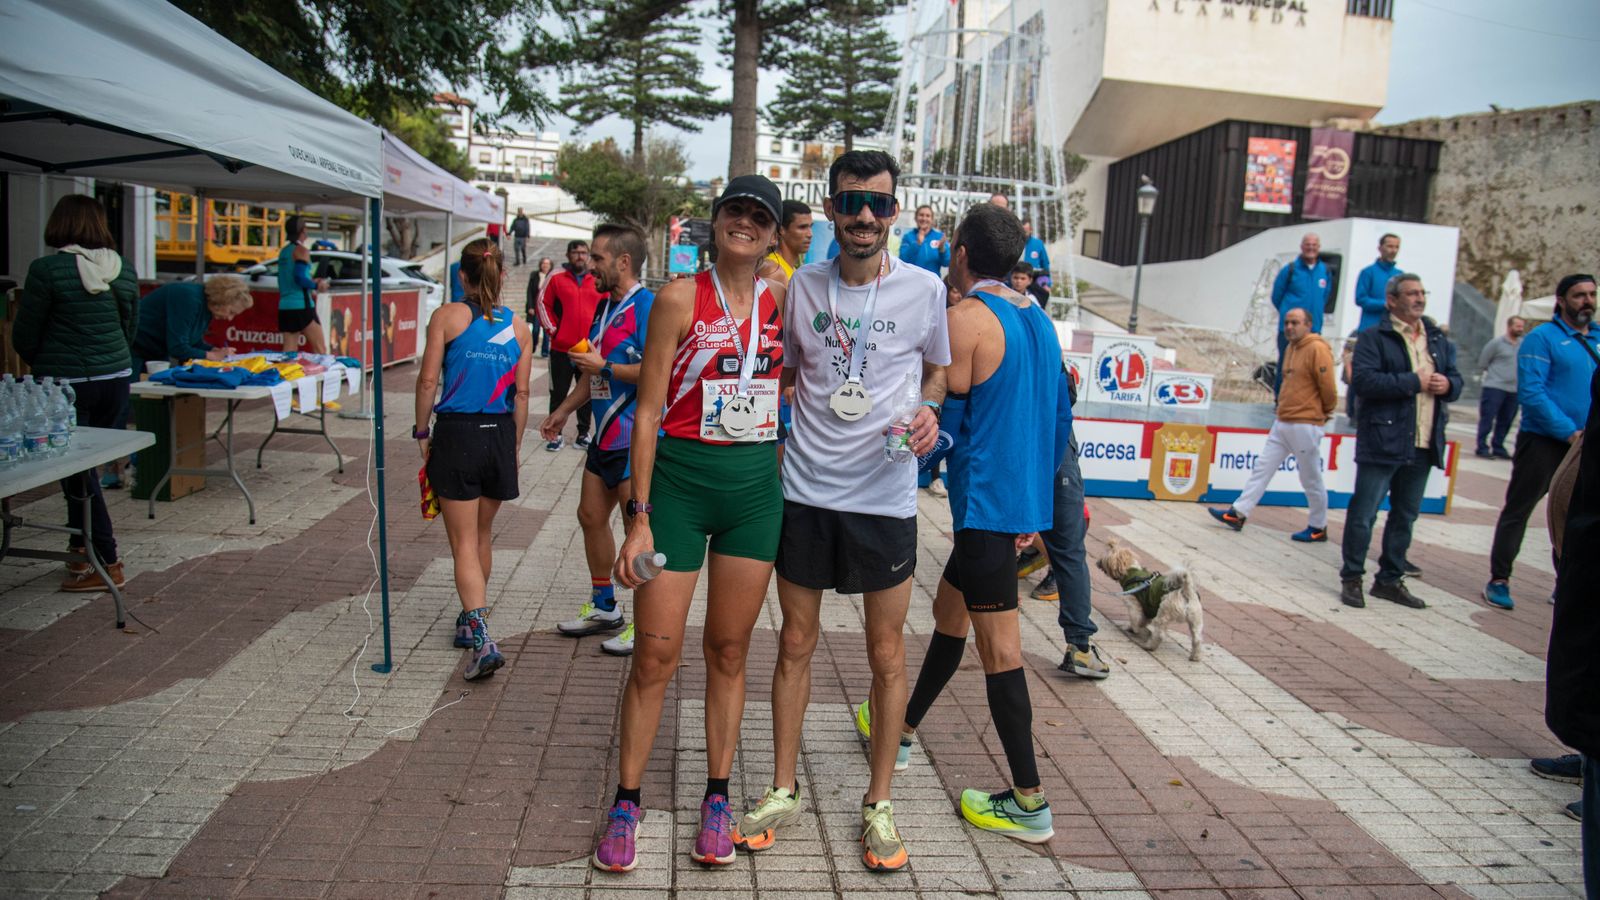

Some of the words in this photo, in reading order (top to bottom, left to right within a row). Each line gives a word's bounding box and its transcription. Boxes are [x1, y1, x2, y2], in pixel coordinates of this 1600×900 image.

[1147, 1, 1306, 27] ALAMEDA
[694, 320, 728, 336] Bilbao
[697, 340, 734, 348] Gueda
[465, 350, 497, 360] Carmona
[1110, 391, 1142, 402] TARIFA
[1077, 441, 1136, 461] vacesa
